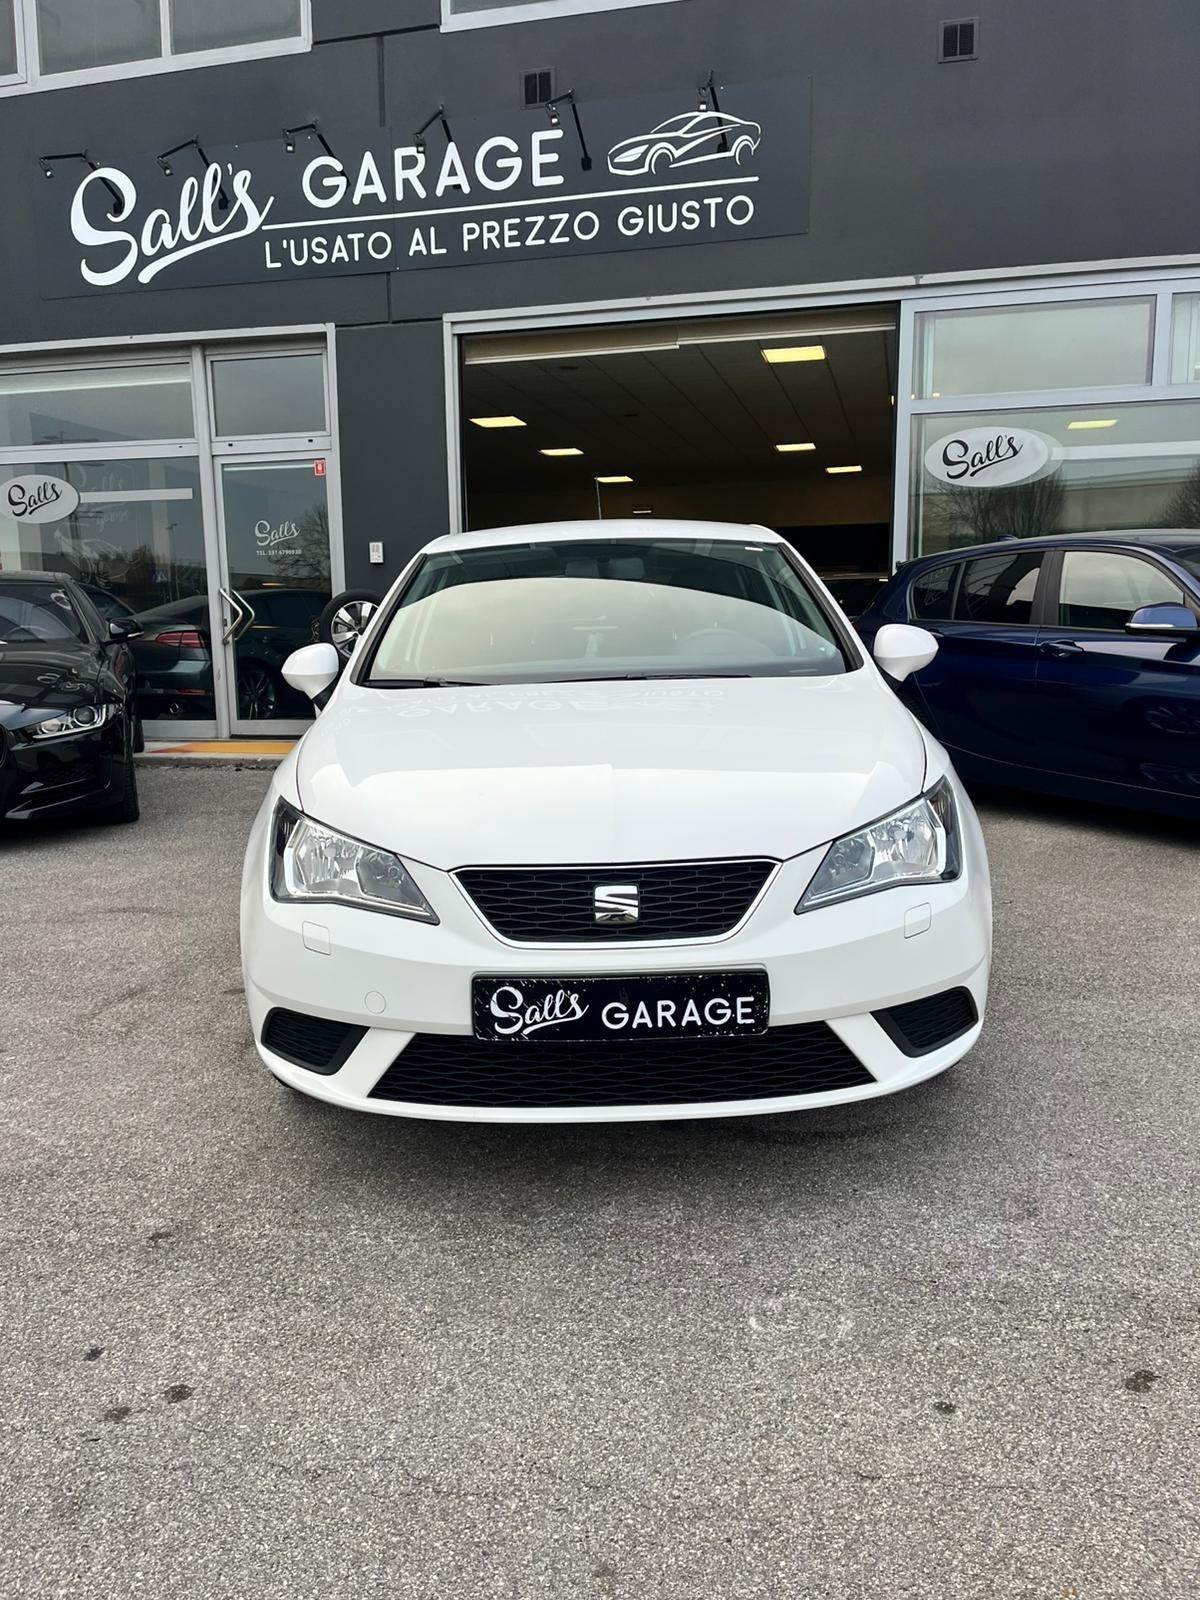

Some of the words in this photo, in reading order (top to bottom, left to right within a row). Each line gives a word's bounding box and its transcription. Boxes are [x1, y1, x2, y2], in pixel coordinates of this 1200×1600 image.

[71, 162, 274, 286] Sall's
[302, 128, 565, 209] GARAGE
[264, 232, 392, 269] L'USATO
[408, 226, 448, 257] AL
[462, 210, 600, 252] PREZZO
[617, 195, 754, 237] GIUSTO
[942, 434, 1024, 480] Sall's
[7, 481, 63, 517] Sall's
[254, 519, 301, 546] Sall's
[490, 985, 589, 1037] Sall's
[601, 996, 755, 1030] GARAGE
